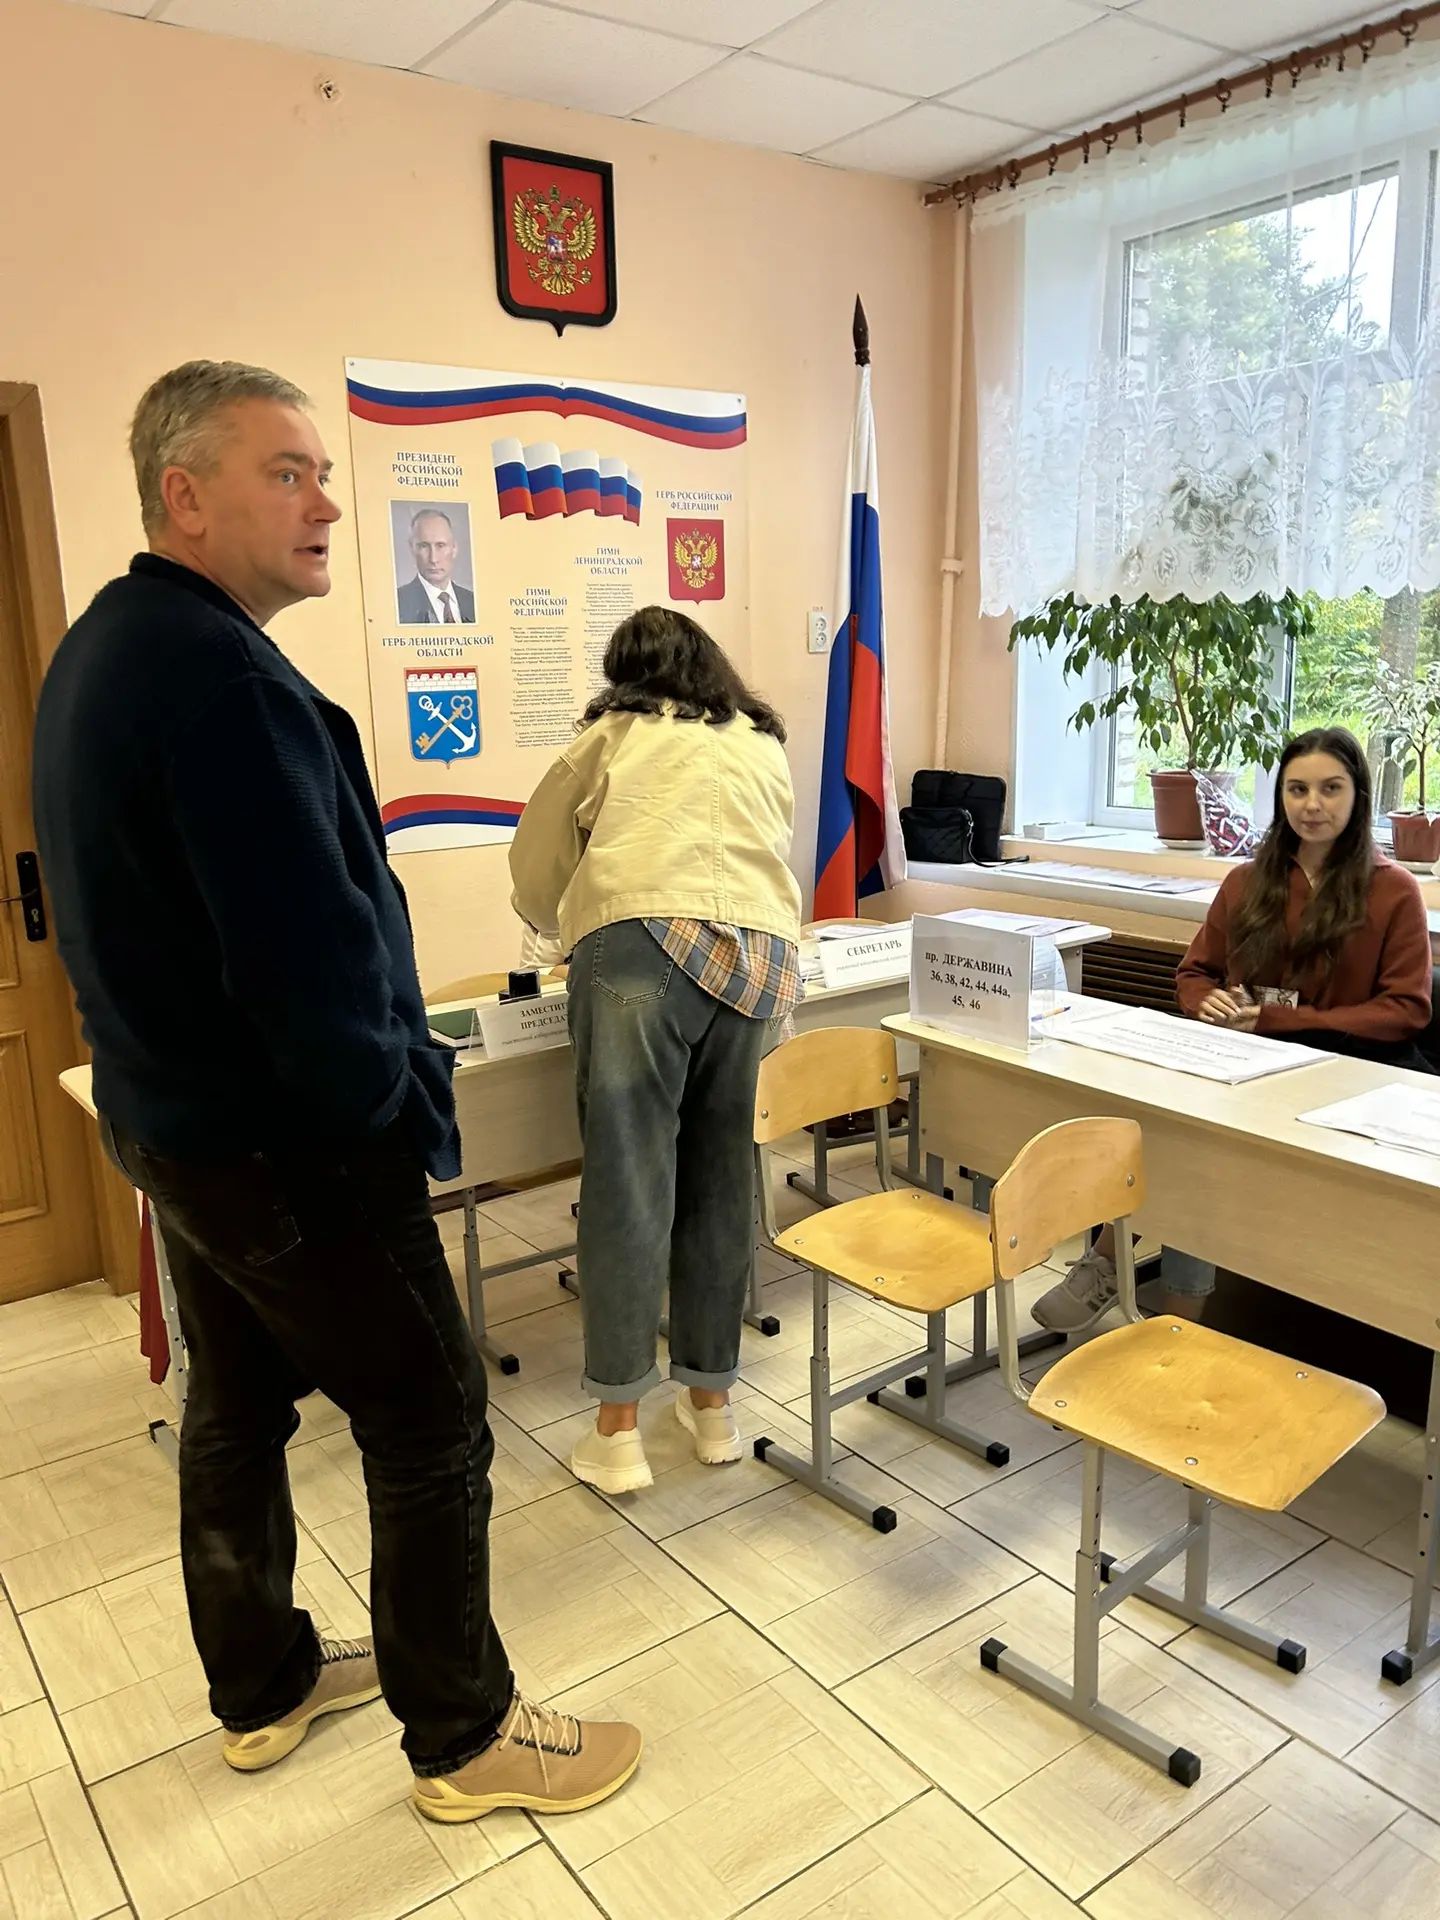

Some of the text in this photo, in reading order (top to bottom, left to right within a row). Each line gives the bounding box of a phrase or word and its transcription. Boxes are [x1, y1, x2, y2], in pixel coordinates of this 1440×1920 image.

[397, 452, 456, 464] ПРЕЗИДЕНТ
[392, 464, 463, 476] РОССИЙСКОЙ
[397, 476, 459, 488] ФЕДЕРАЦИИ
[656, 490, 733, 502] ГЕРБ РОССИЙСКОЙ
[670, 501, 719, 511] ФЕДЕРАЦИИ
[596, 547, 620, 556] ГИМН
[574, 556, 643, 566] ЛЕНИНГРАДСКОЙ
[590, 566, 628, 575] ОБЛАСТИ
[526, 588, 551, 596] ГИМН
[510, 597, 568, 606] РОССИЙСКОЙ
[514, 608, 564, 616] ФЕДЕРАЦИИ
[382, 635, 495, 647] ГЕРБ ЛЕНИНГРАДСКОЙ
[416, 648, 464, 657] ОБЛАСТИ
[846, 939, 902, 957] СЕКРЕТАРЬ
[925, 952, 939, 963] пр.
[942, 953, 1013, 977] ДЕРЖАВИНА
[930, 970, 1011, 998] 36, 38, 42, 44, 44а,
[952, 994, 981, 1010] 45, 46
[520, 1002, 568, 1018] ЗАМЕСТИТ
